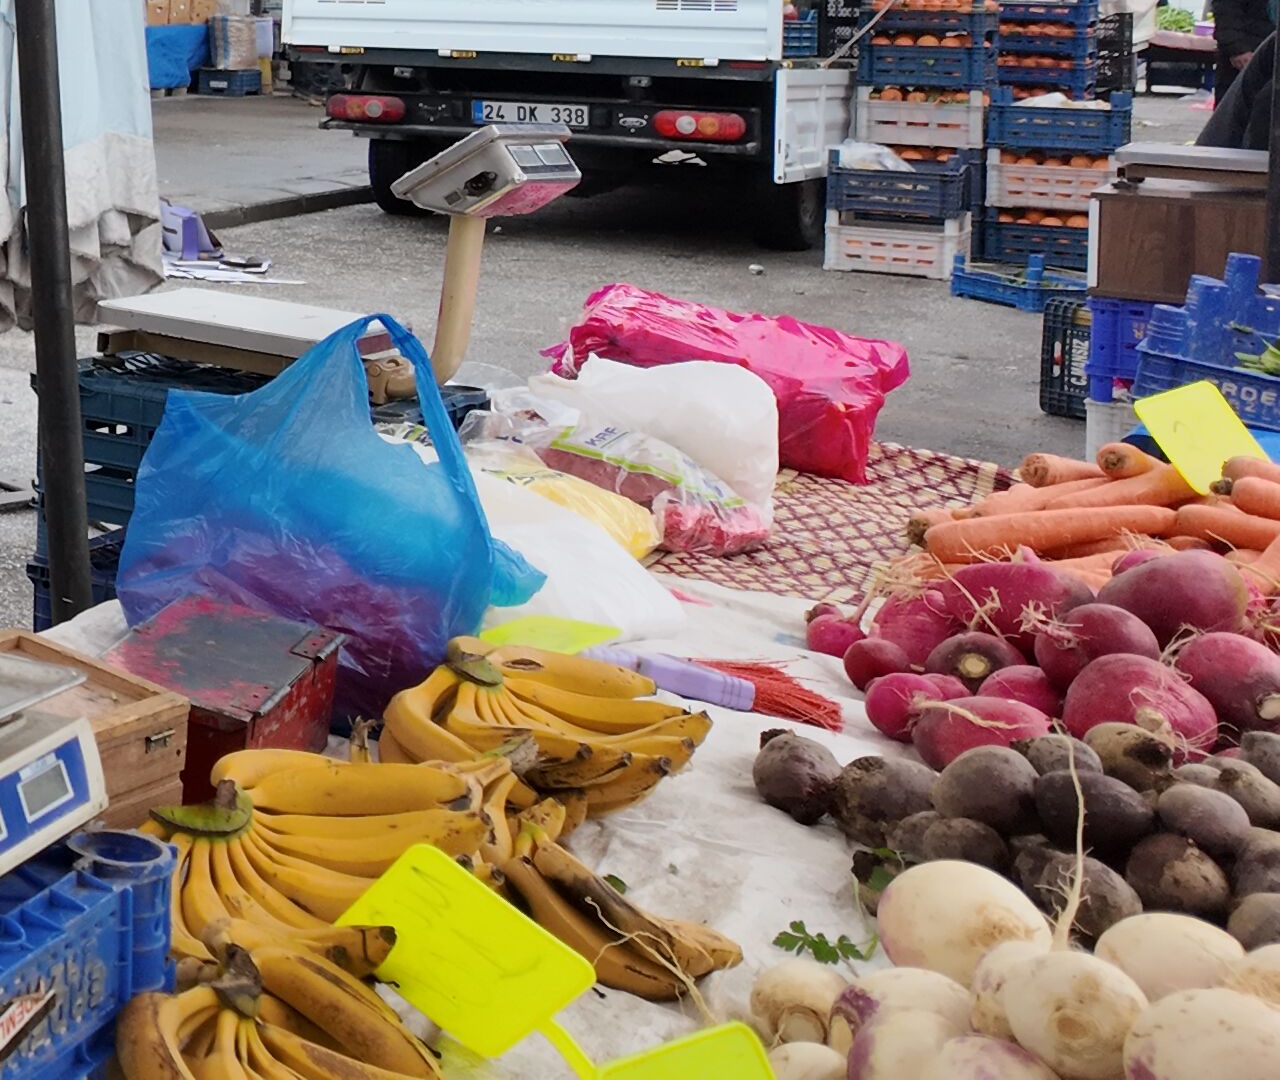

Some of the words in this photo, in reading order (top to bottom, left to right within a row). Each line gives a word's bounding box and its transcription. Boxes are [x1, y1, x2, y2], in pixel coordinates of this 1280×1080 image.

[484, 104, 505, 120] 24
[516, 105, 538, 122] DK
[550, 107, 585, 125] 338
